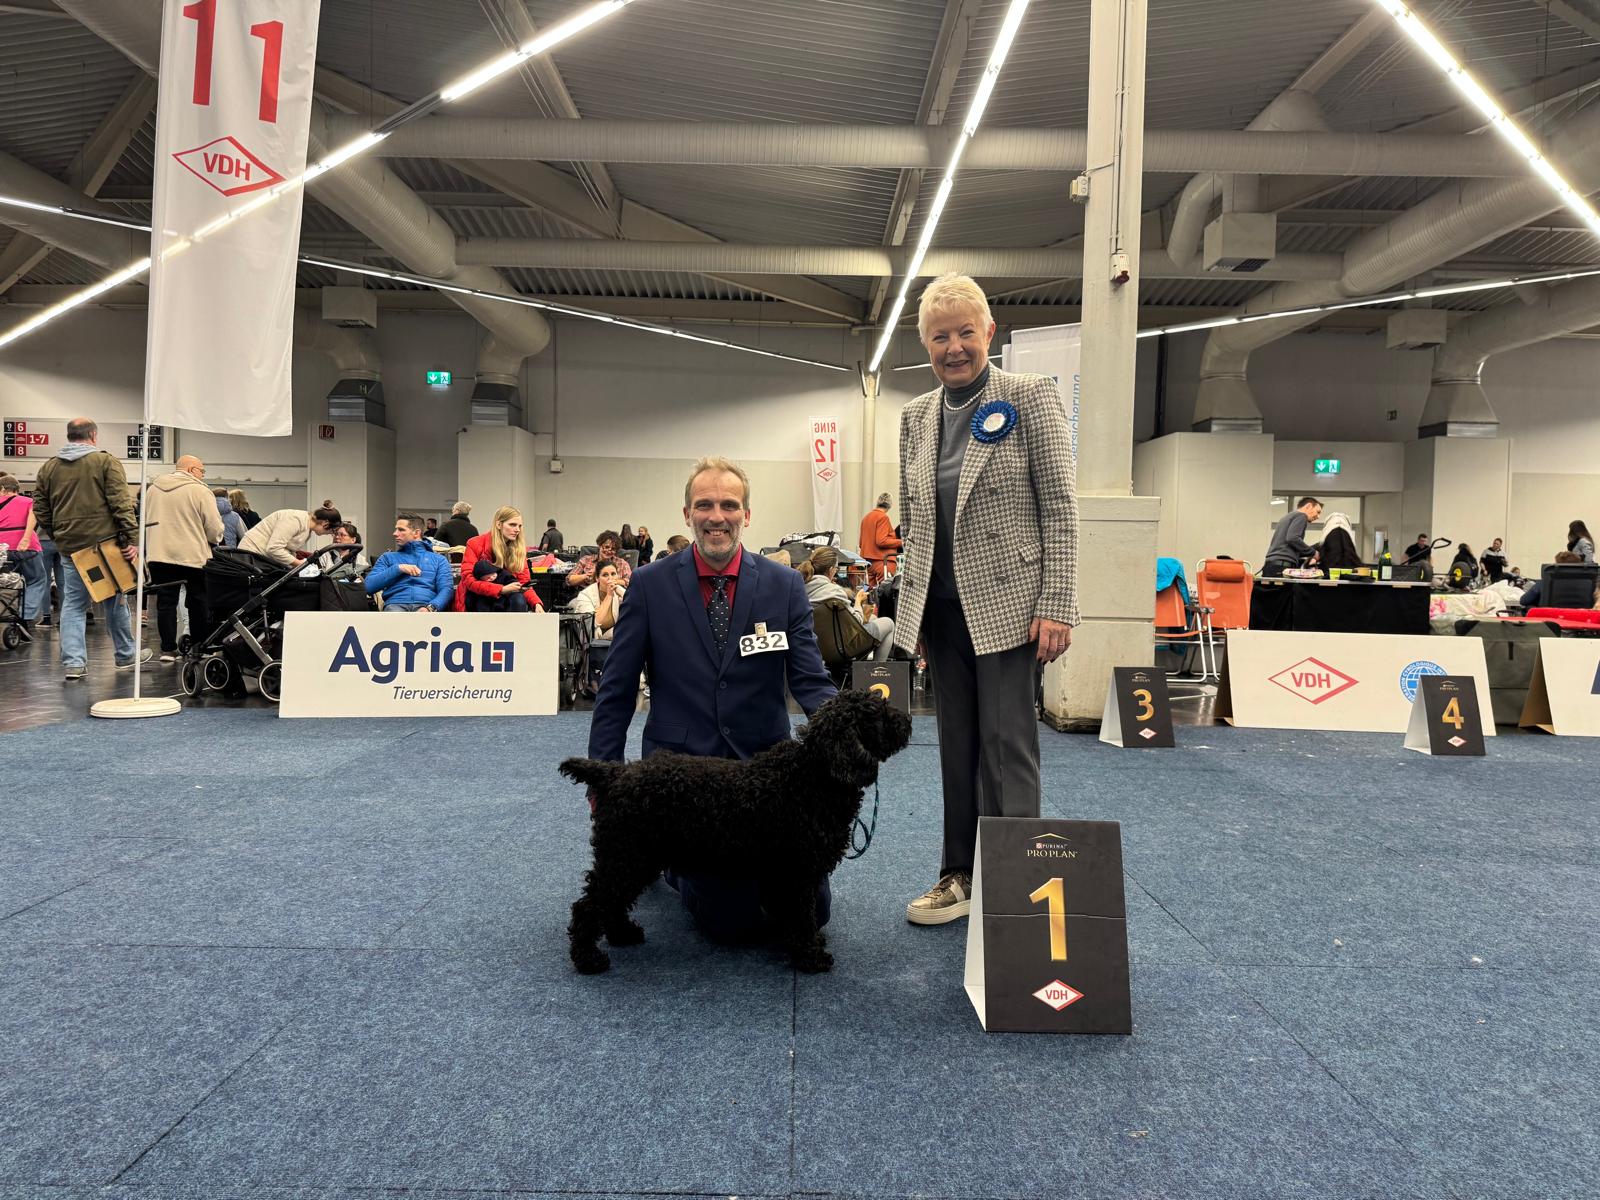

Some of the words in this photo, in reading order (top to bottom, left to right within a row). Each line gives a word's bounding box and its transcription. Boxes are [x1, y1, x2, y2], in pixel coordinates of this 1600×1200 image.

[183, 0, 283, 123] 11
[203, 152, 251, 181] VDH
[17, 422, 25, 432] 6
[29, 434, 46, 444] 1-7
[17, 446, 24, 456] 8
[741, 633, 785, 652] 832
[328, 626, 474, 684] Agria
[1291, 672, 1331, 688] VDH
[393, 685, 513, 703] Tierversicherung
[1133, 688, 1155, 721] 3
[1442, 697, 1465, 730] 4
[1027, 849, 1048, 857] PRO
[1049, 850, 1077, 858] PLAN
[1029, 878, 1067, 961] 1
[1045, 989, 1068, 1001] VDH
